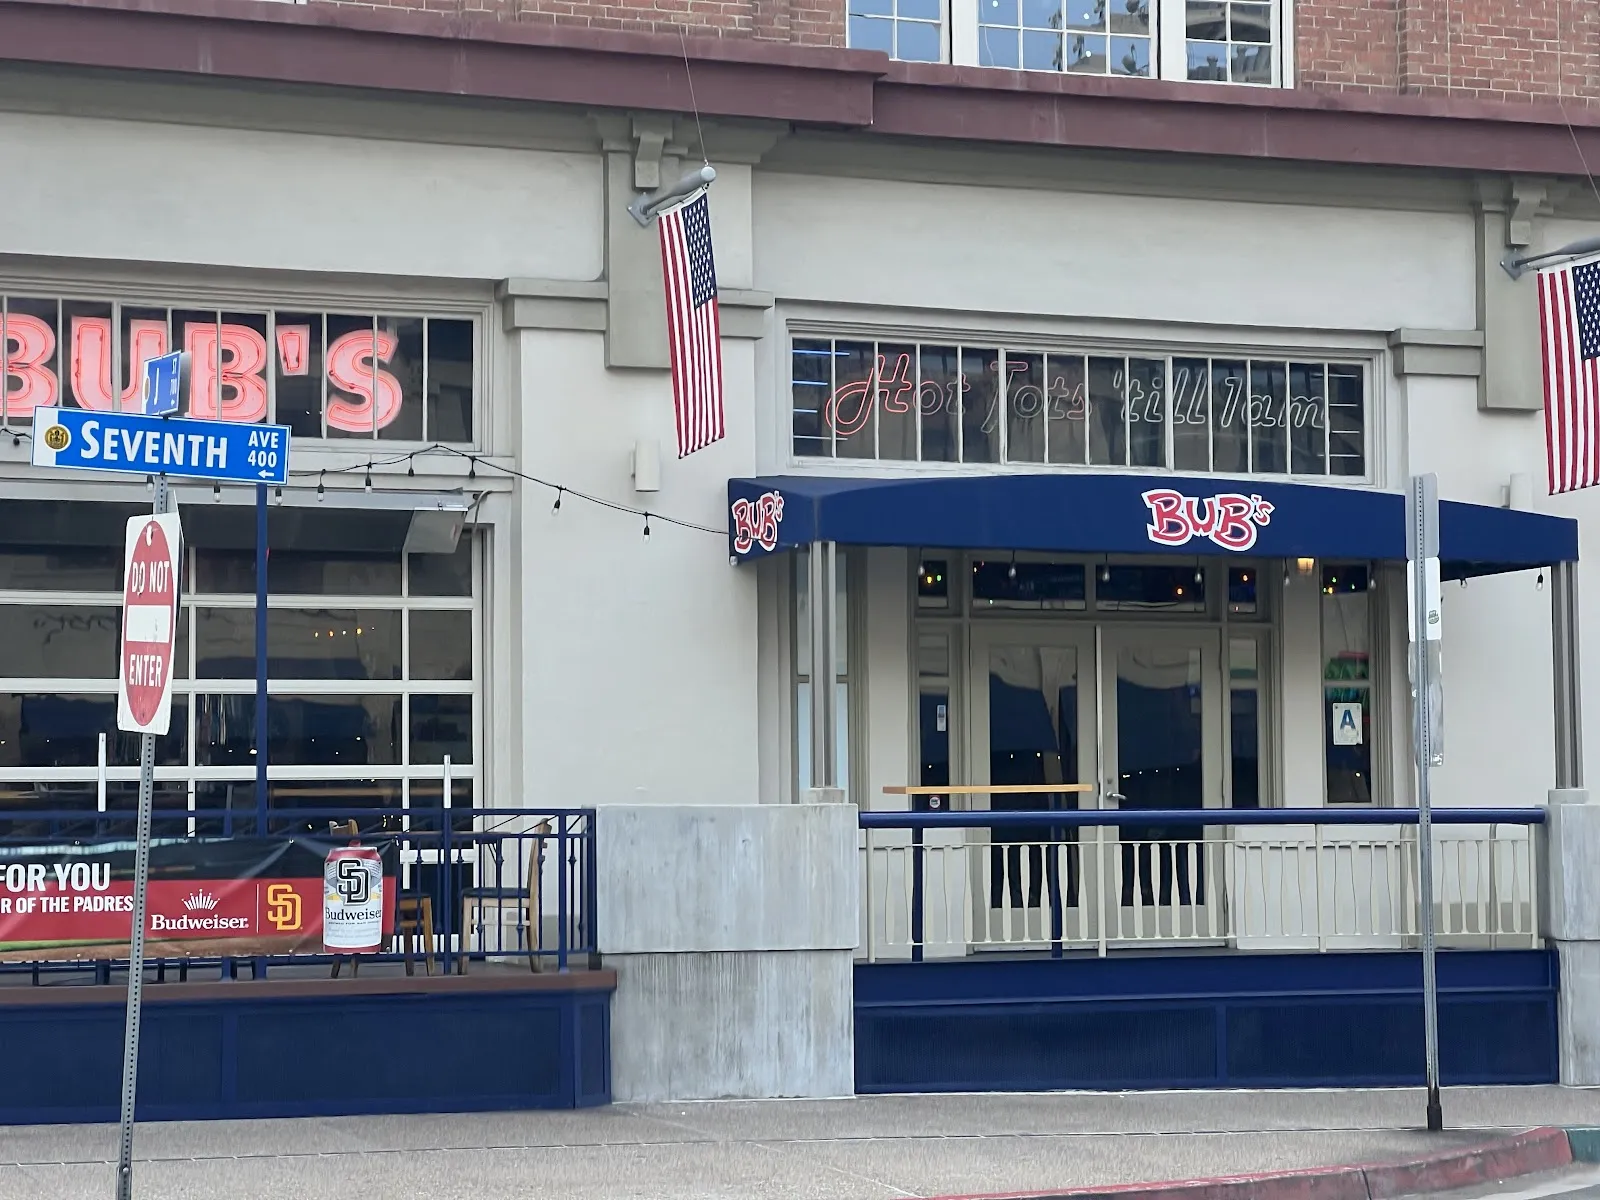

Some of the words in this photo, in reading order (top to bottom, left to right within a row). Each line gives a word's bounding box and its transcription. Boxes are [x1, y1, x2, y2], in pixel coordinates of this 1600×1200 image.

[0, 312, 403, 433] BUB'S
[825, 353, 971, 435] Hot
[981, 361, 1093, 433] Tots
[80, 420, 228, 469] SEVENTH
[248, 430, 279, 449] AVE
[247, 451, 277, 468] 400
[131, 561, 145, 593] DO
[149, 561, 169, 593] NOT
[129, 654, 162, 687] ENTER
[1340, 709, 1356, 730] A
[53, 863, 111, 891] YOU
[15, 897, 37, 914] OF
[40, 896, 70, 913] THE
[73, 895, 134, 912] PADRES
[267, 884, 302, 930] SD
[150, 914, 249, 930] Budweiser
